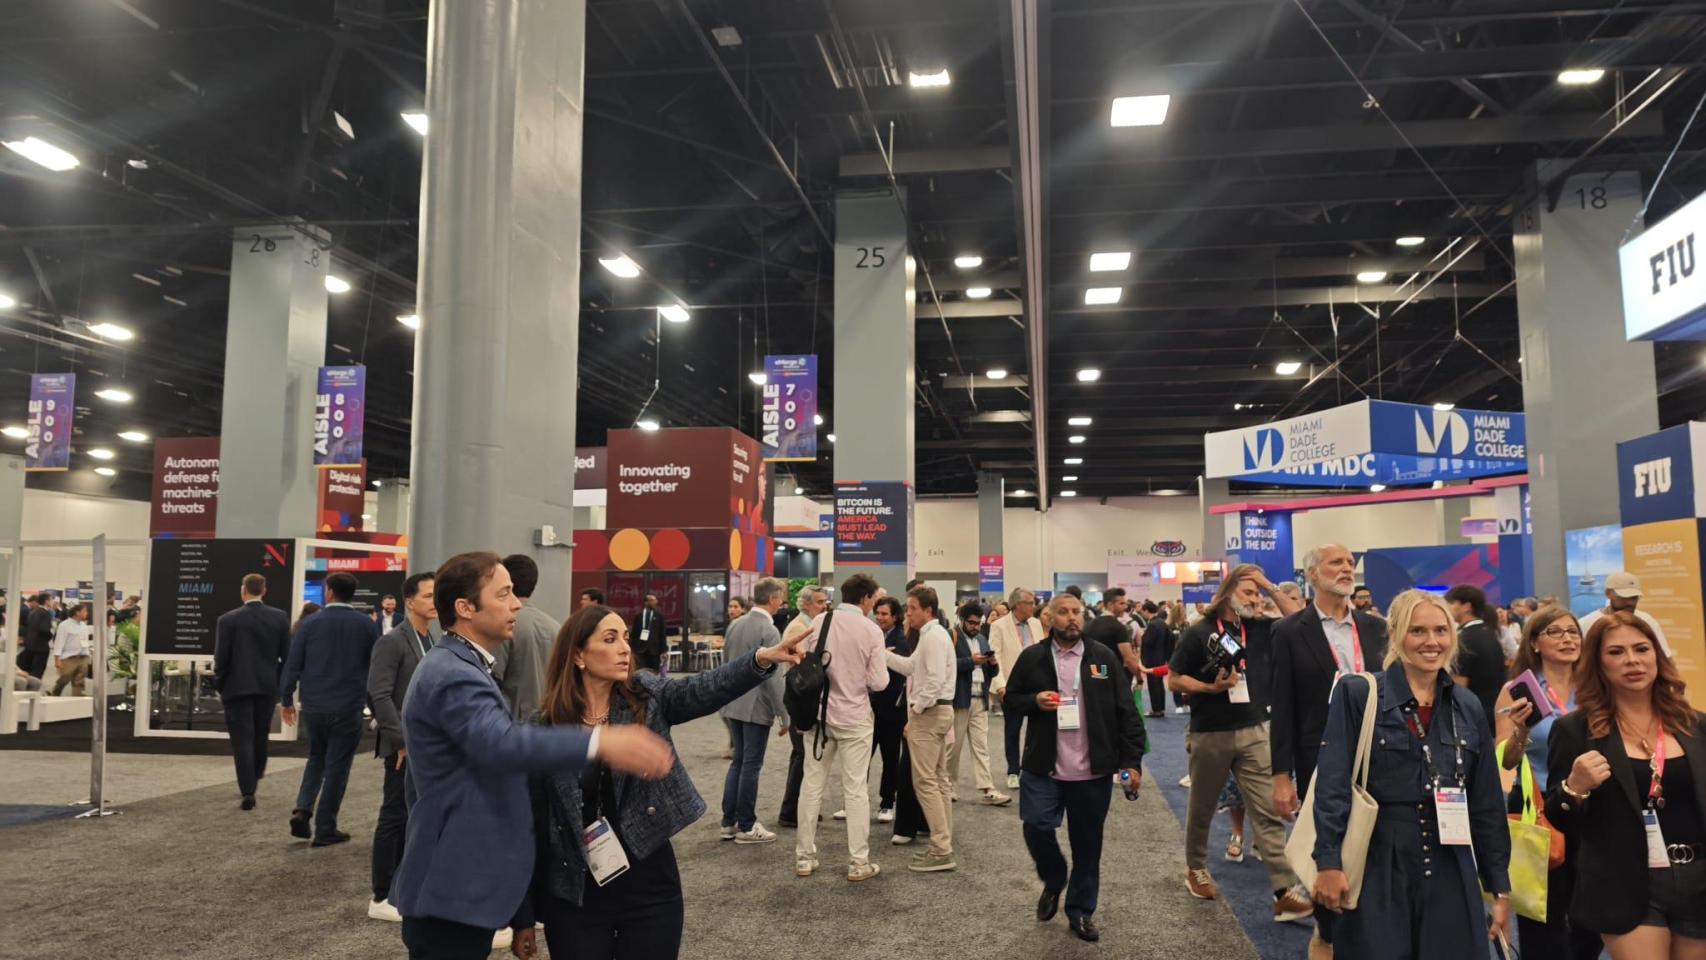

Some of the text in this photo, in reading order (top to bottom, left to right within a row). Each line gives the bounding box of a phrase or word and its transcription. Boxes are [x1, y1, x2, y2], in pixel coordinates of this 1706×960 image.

[1575, 186, 1608, 210] 18
[855, 246, 885, 268] 25
[1649, 232, 1696, 296] FIU
[784, 383, 796, 431] 700
[43, 399, 56, 443] 900
[333, 392, 345, 438] 800
[762, 383, 780, 448] AISLE
[1473, 414, 1511, 429] MIAMI
[25, 399, 43, 459] AISLE
[313, 393, 331, 456] AISLE
[1289, 418, 1323, 436] MIAMI
[1290, 433, 1318, 449] DADE
[1474, 429, 1506, 444] DADE
[1290, 442, 1336, 463] COLLEGE
[1475, 443, 1525, 458] COLLEGE
[619, 464, 691, 479] Innovating
[1321, 453, 1377, 477] MDC
[163, 470, 210, 484] defense
[1633, 456, 1672, 498] FIU
[619, 480, 678, 496] together
[161, 501, 206, 514] threats
[837, 498, 883, 506] BITCOIN IS
[837, 506, 894, 515] THE FUTURE.
[837, 515, 878, 523] AMERICA
[1244, 516, 1268, 526] THINK
[837, 523, 861, 532] MUST
[863, 523, 887, 532] LEAD
[1244, 528, 1278, 539] OUTSIDE
[837, 532, 855, 540] THE
[1245, 540, 1260, 550] THE
[927, 549, 944, 557] Exit
[1107, 549, 1125, 557] Exit
[328, 559, 360, 569] MIAMI
[178, 583, 214, 593] MIAMI
